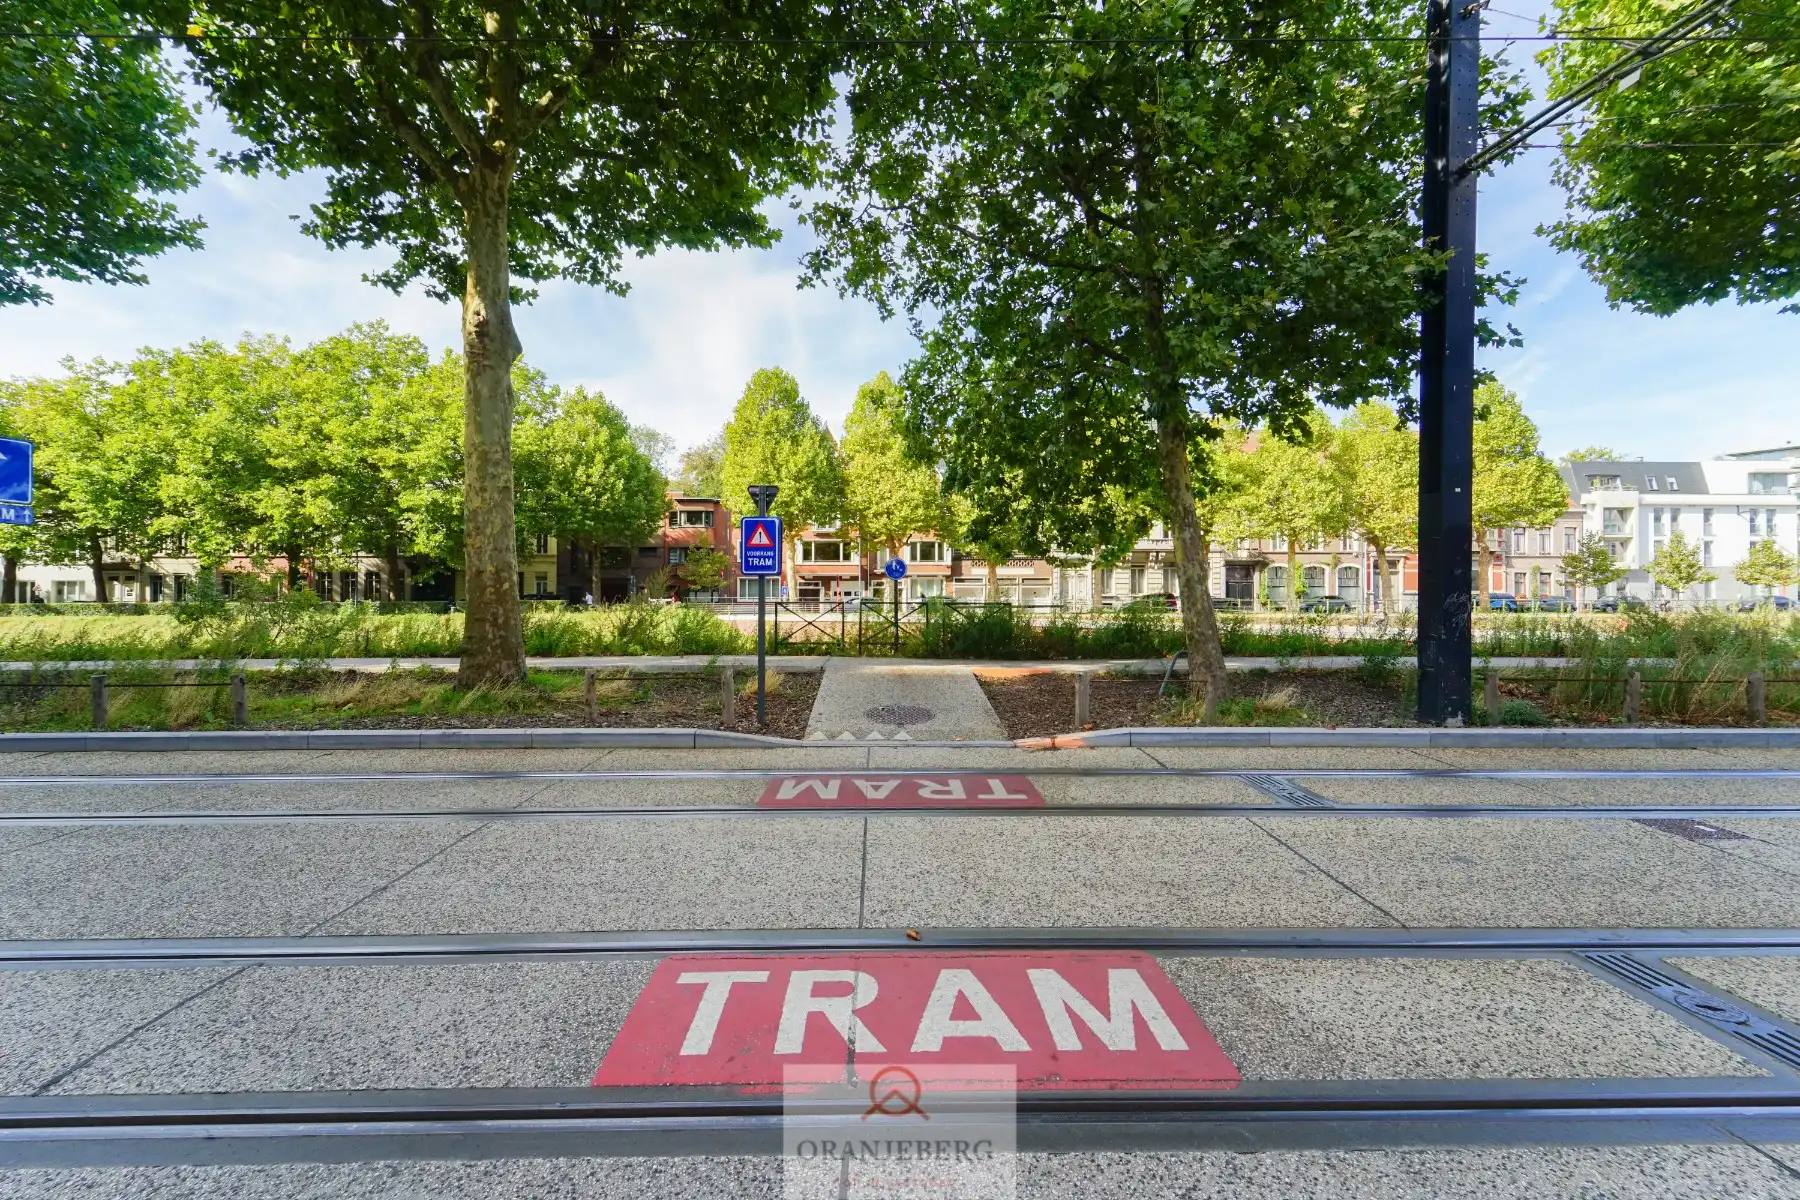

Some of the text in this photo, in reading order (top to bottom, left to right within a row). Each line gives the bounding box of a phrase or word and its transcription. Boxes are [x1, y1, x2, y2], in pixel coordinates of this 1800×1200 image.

[747, 557, 773, 566] TRAM
[774, 778, 1029, 800] TRAM
[676, 968, 1190, 1055] TRAM
